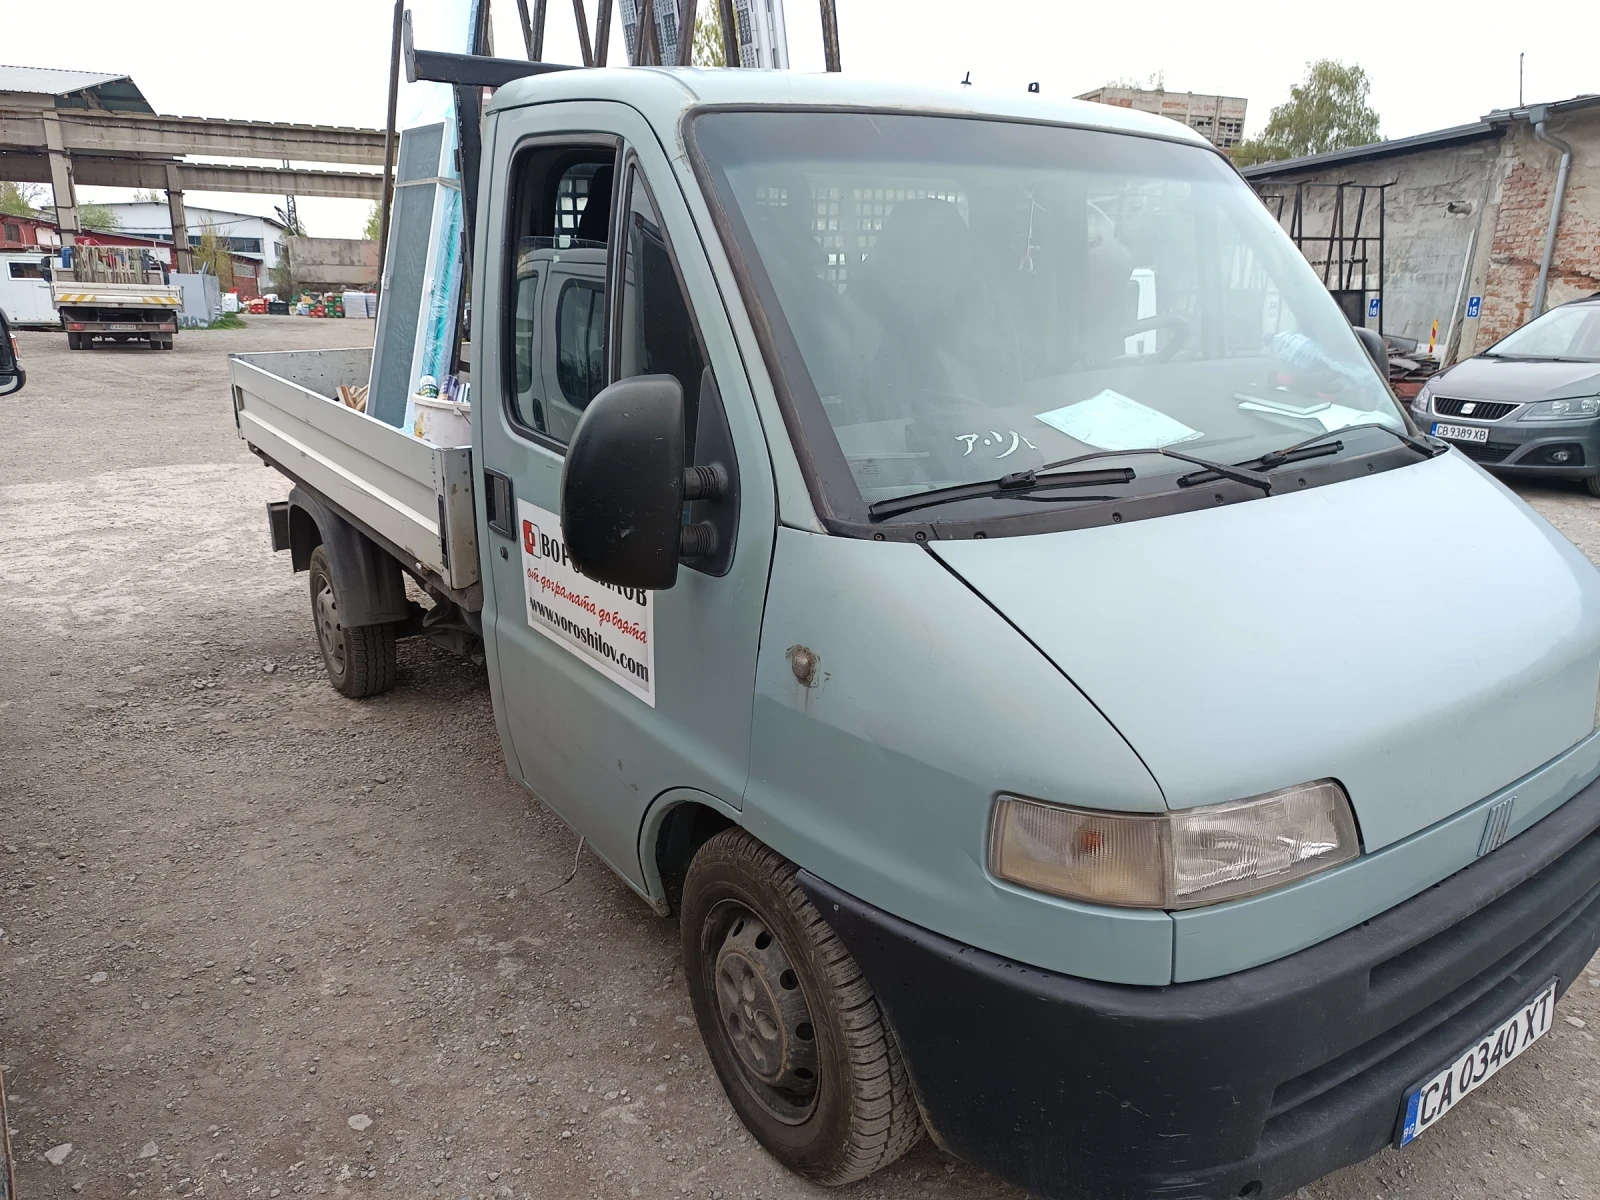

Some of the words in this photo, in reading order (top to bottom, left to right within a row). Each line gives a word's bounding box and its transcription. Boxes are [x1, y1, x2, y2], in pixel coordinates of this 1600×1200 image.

[1468, 306, 1478, 316] 15
[1436, 425, 1449, 436] CB
[1450, 427, 1473, 439] 9389
[1473, 429, 1487, 441] XB
[527, 567, 540, 582] от
[540, 576, 597, 616] дограмата
[612, 611, 648, 644] боята
[529, 596, 649, 683] www.voroshilov.com
[1419, 1070, 1454, 1126] CA
[1459, 1019, 1519, 1094] 0340
[1522, 989, 1553, 1048] XT
[1403, 1122, 1415, 1138] BG
